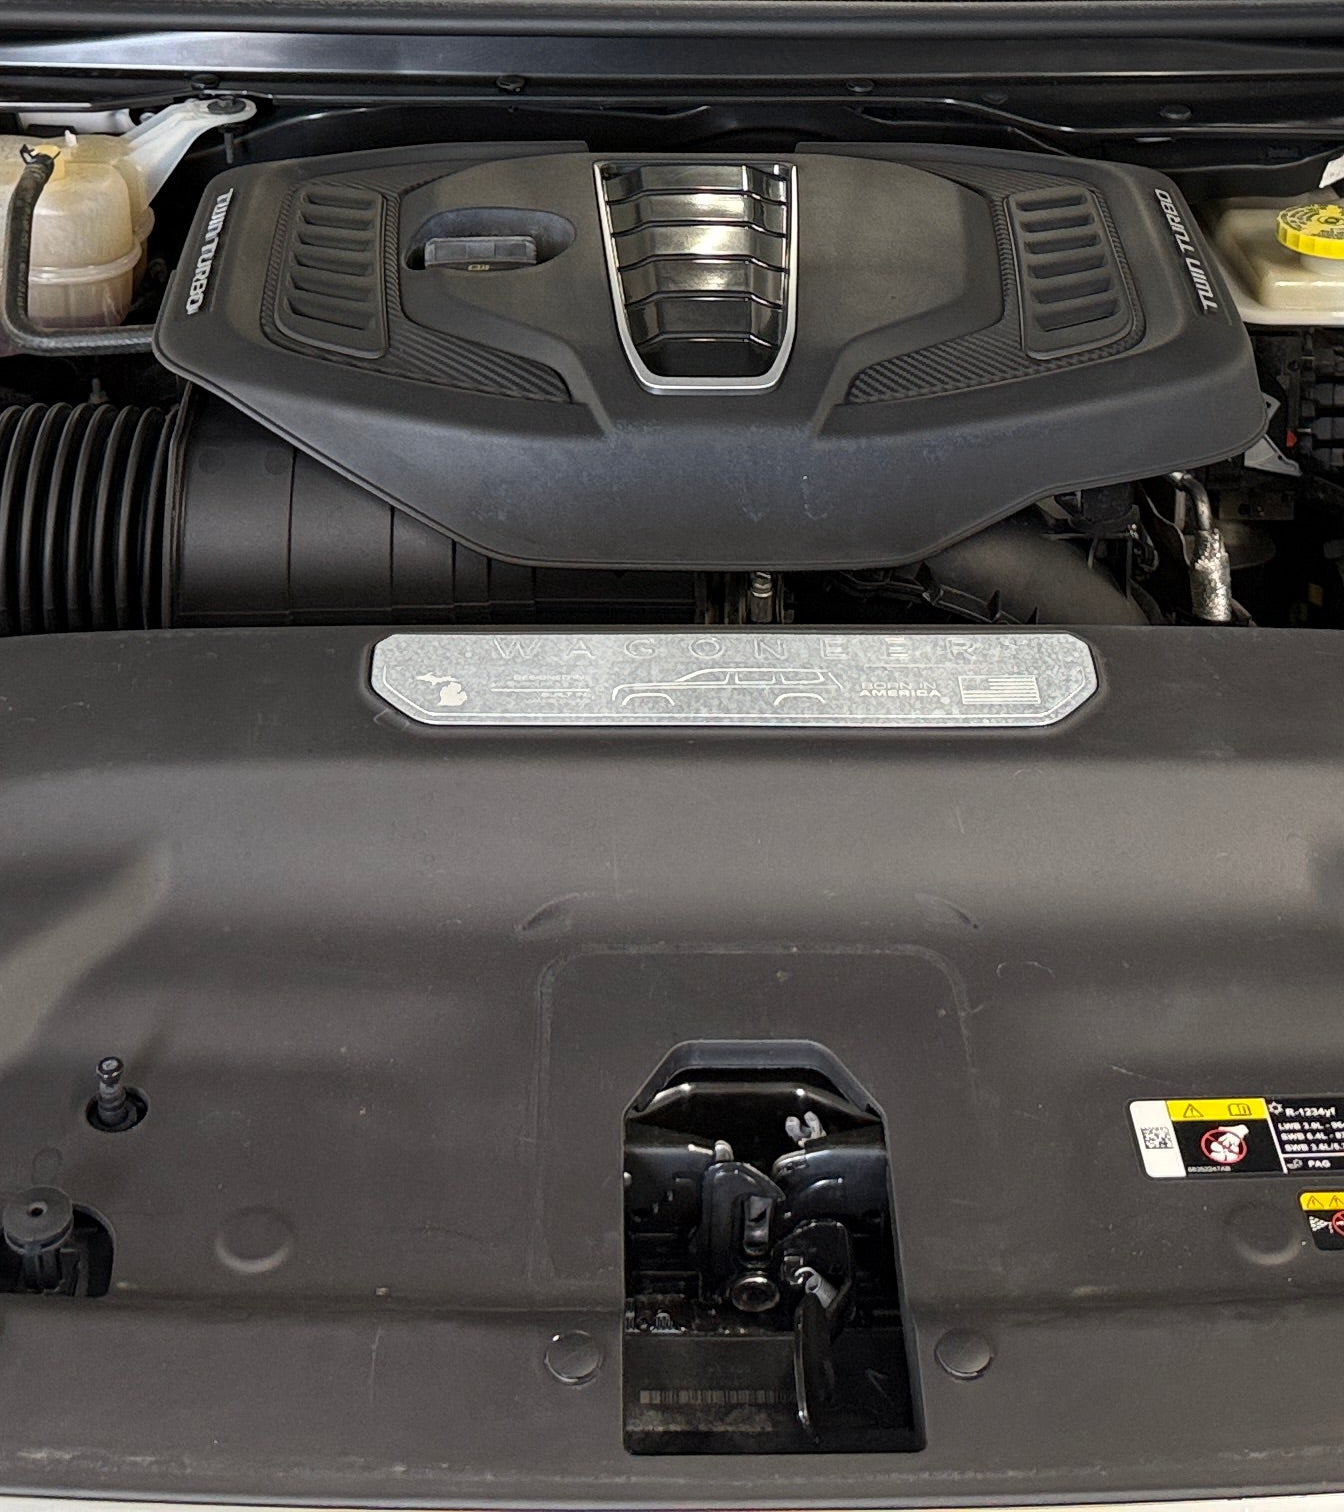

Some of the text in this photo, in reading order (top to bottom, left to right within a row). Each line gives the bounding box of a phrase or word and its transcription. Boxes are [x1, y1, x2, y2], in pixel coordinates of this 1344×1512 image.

[186, 188, 234, 315] TWIN TURBO
[1154, 188, 1218, 310] TWIN TURBO
[492, 637, 975, 660] WAGONEER
[861, 681, 938, 689] BORN IN
[859, 689, 941, 698] AMERICA
[1307, 1160, 1331, 1168] PAG
